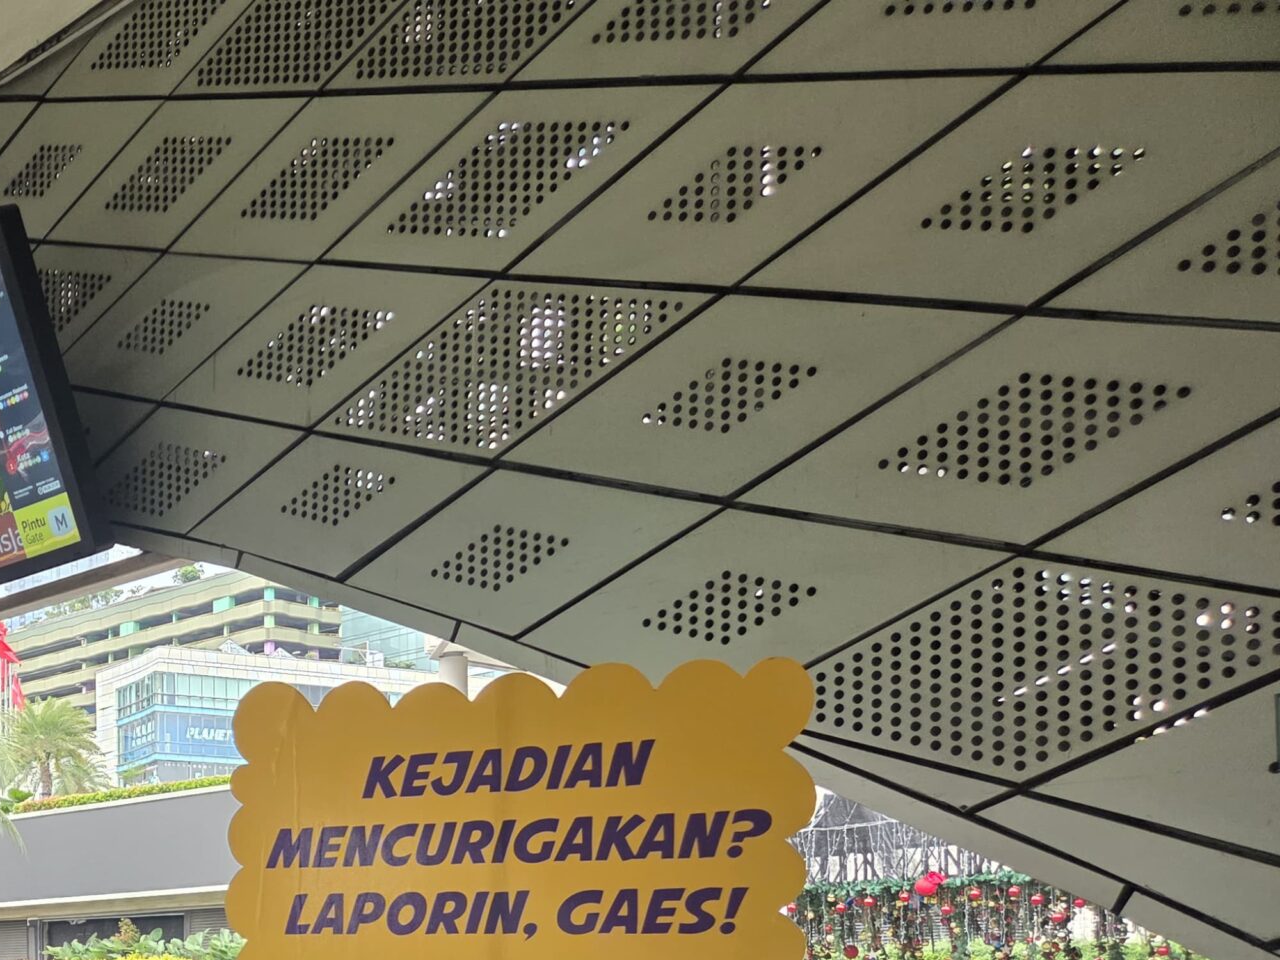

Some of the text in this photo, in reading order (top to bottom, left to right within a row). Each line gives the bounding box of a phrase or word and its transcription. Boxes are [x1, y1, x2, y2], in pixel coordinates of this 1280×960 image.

[21, 516, 47, 533] Pintu
[25, 530, 45, 545] Gate
[54, 513, 69, 532] M
[361, 738, 656, 799] KEJADIAN
[265, 808, 772, 869] MENCURIGAKAN?
[284, 886, 749, 942] LAPORIN, GAES!
